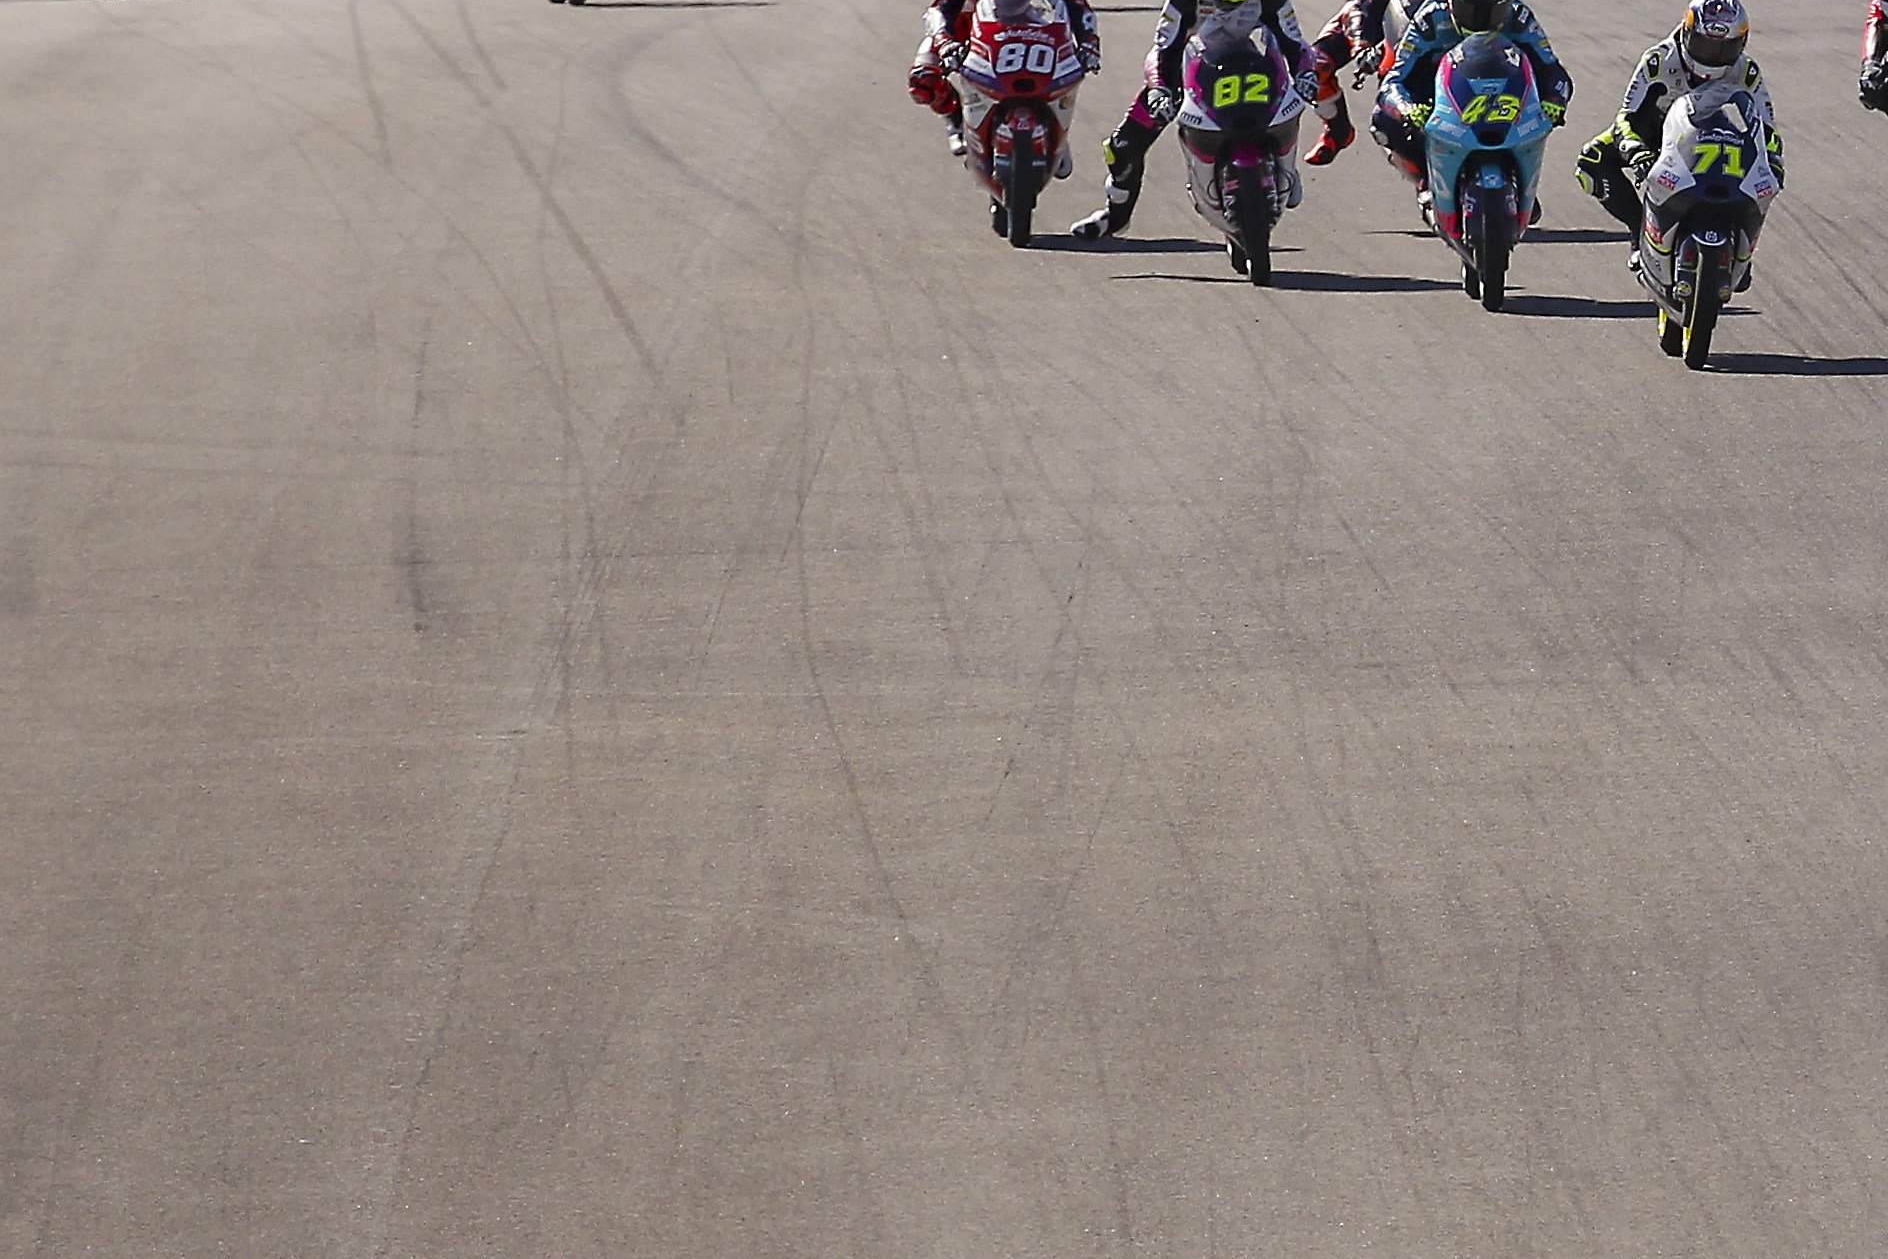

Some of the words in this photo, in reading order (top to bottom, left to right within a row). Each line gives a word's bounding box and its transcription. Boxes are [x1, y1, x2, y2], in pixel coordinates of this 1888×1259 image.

[995, 43, 1055, 74] 80
[1213, 73, 1269, 108] 82
[1461, 94, 1521, 125] 43
[1692, 142, 1746, 178] 71
